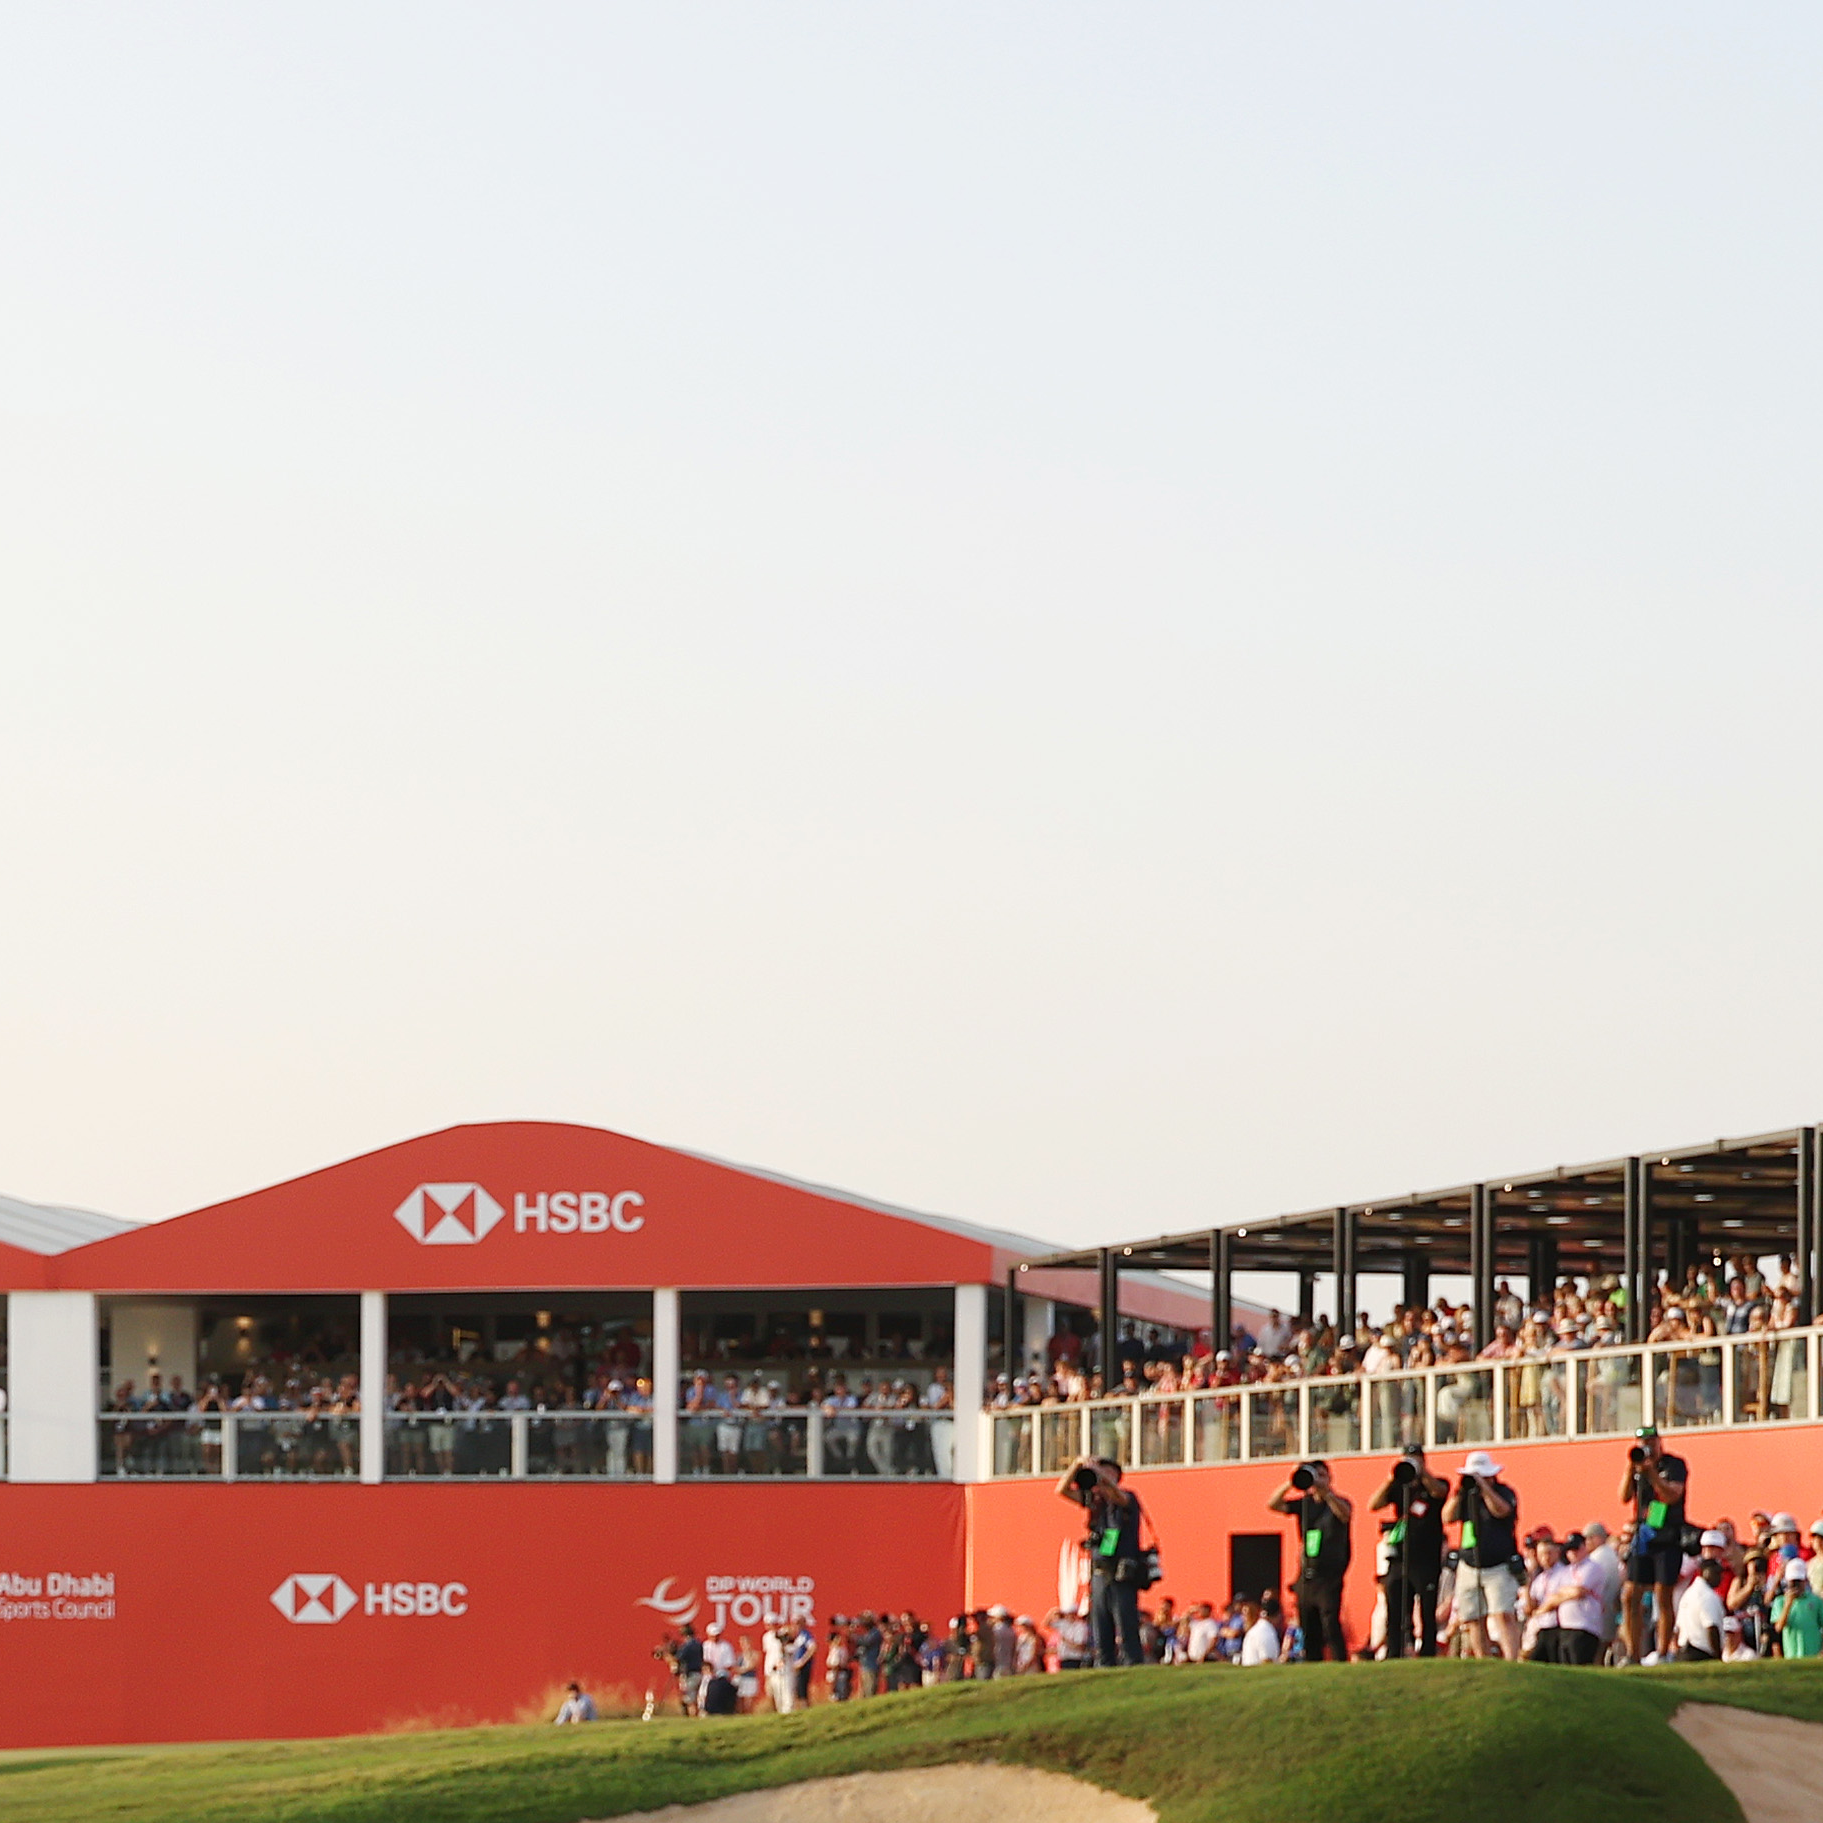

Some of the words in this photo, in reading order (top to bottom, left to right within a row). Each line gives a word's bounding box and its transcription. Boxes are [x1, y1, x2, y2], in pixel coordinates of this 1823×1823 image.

[513, 1190, 645, 1233] HSBC
[46, 1572, 115, 1597] Dhabi
[363, 1581, 469, 1617] HSBC
[705, 1576, 735, 1592] DP
[736, 1576, 815, 1593] WORLD
[52, 1597, 116, 1620] Council
[706, 1593, 817, 1627] TOUR
